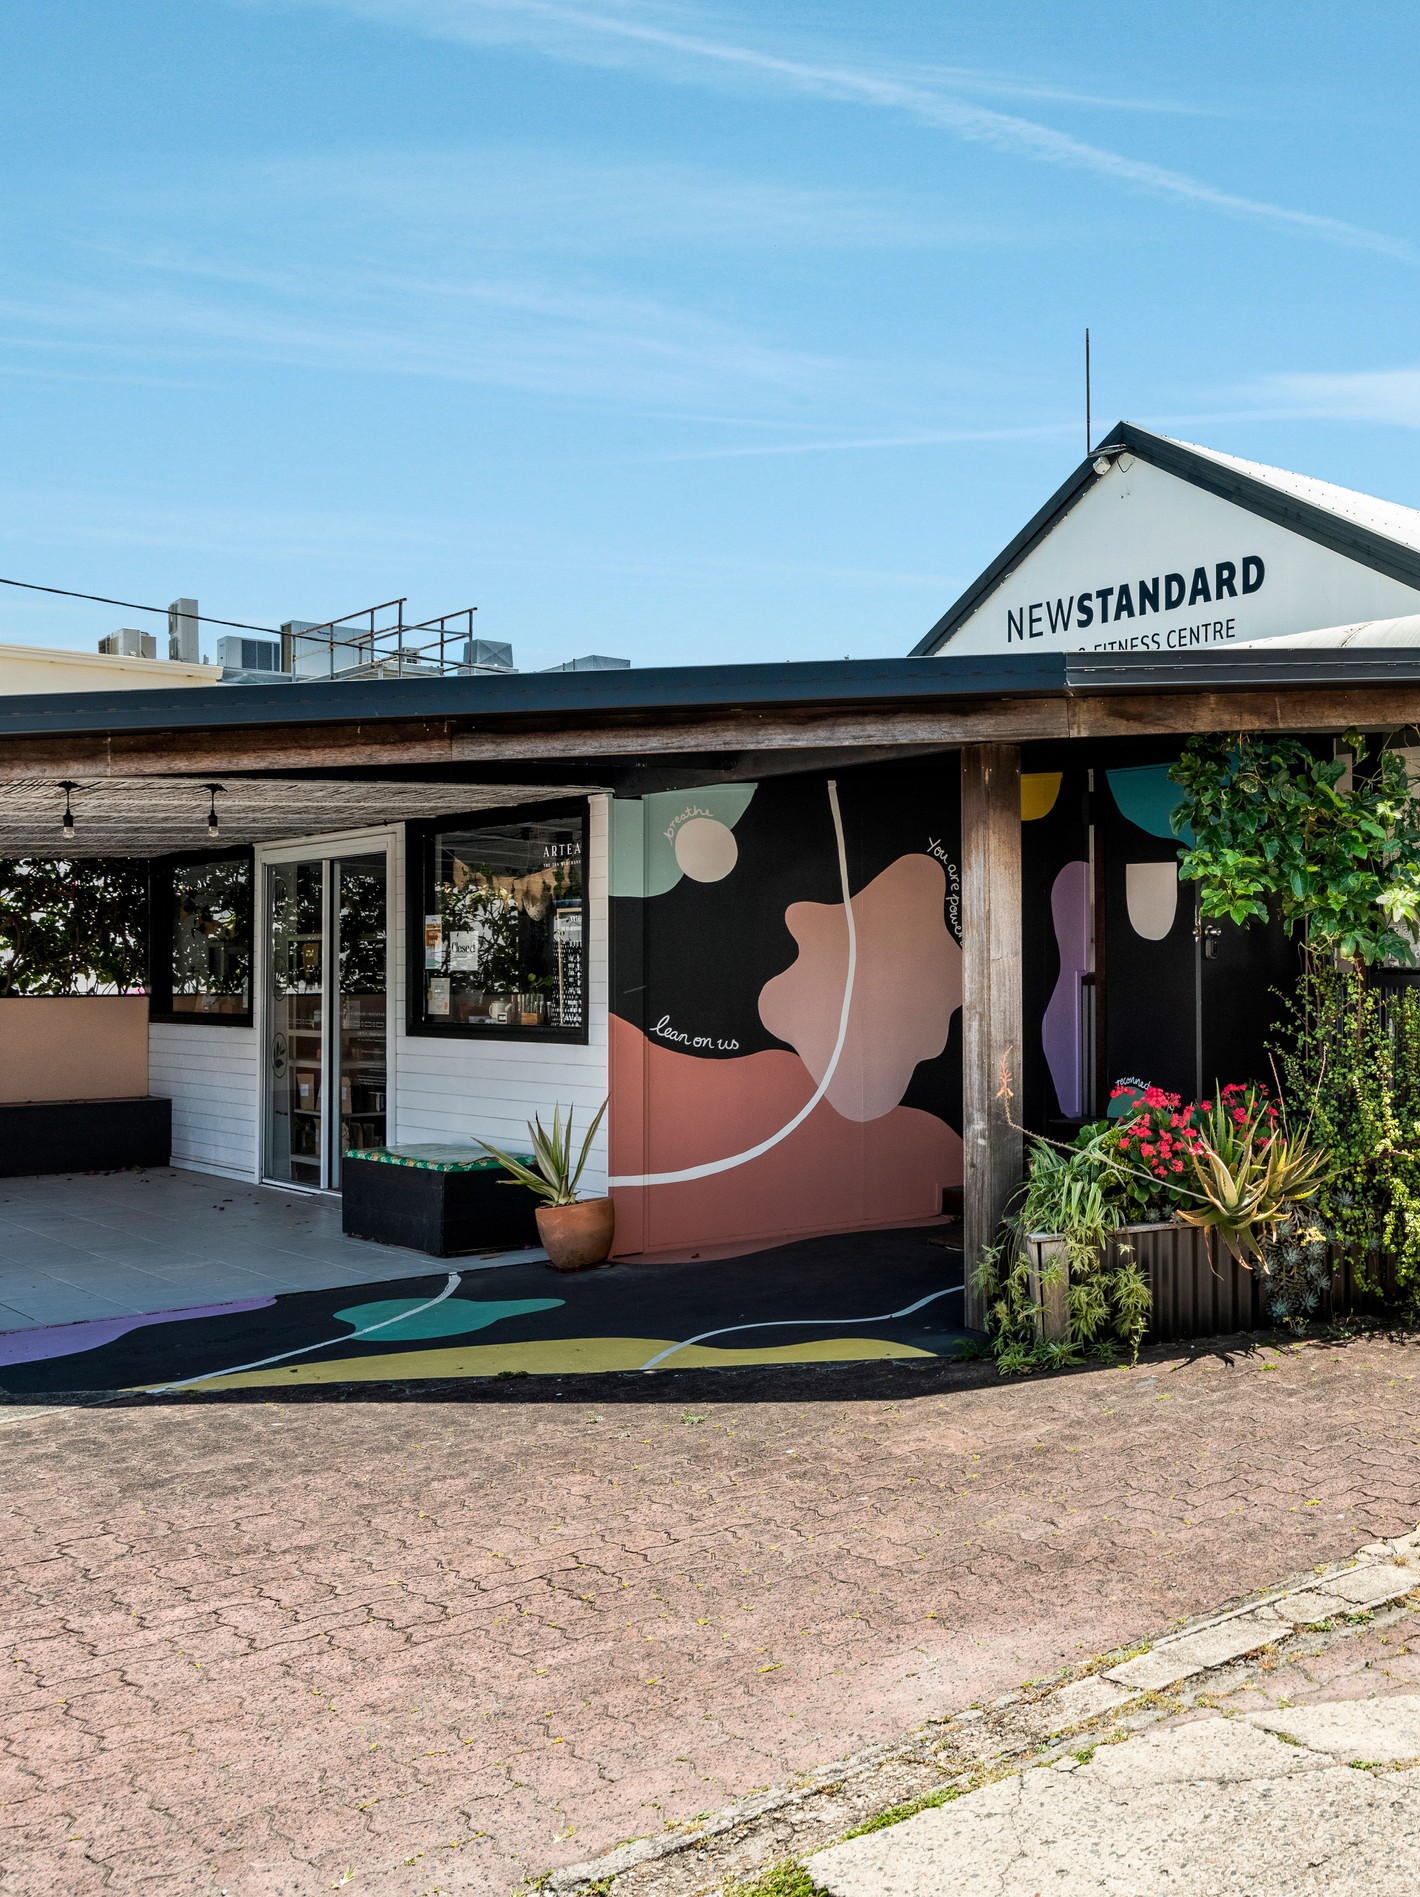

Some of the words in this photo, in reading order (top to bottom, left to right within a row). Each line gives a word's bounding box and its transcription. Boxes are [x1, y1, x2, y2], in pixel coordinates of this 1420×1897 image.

[1007, 555, 1265, 643] NEWSTANDARD
[1167, 618, 1236, 649] CENTRE
[663, 805, 714, 847] breathe
[543, 843, 581, 858] ARTEA
[927, 837, 948, 864] You
[948, 864, 960, 891] are
[945, 893, 962, 947] powe
[451, 941, 476, 954] Closed
[649, 1015, 692, 1045] lean
[693, 1037, 715, 1048] on
[717, 1039, 740, 1050] us
